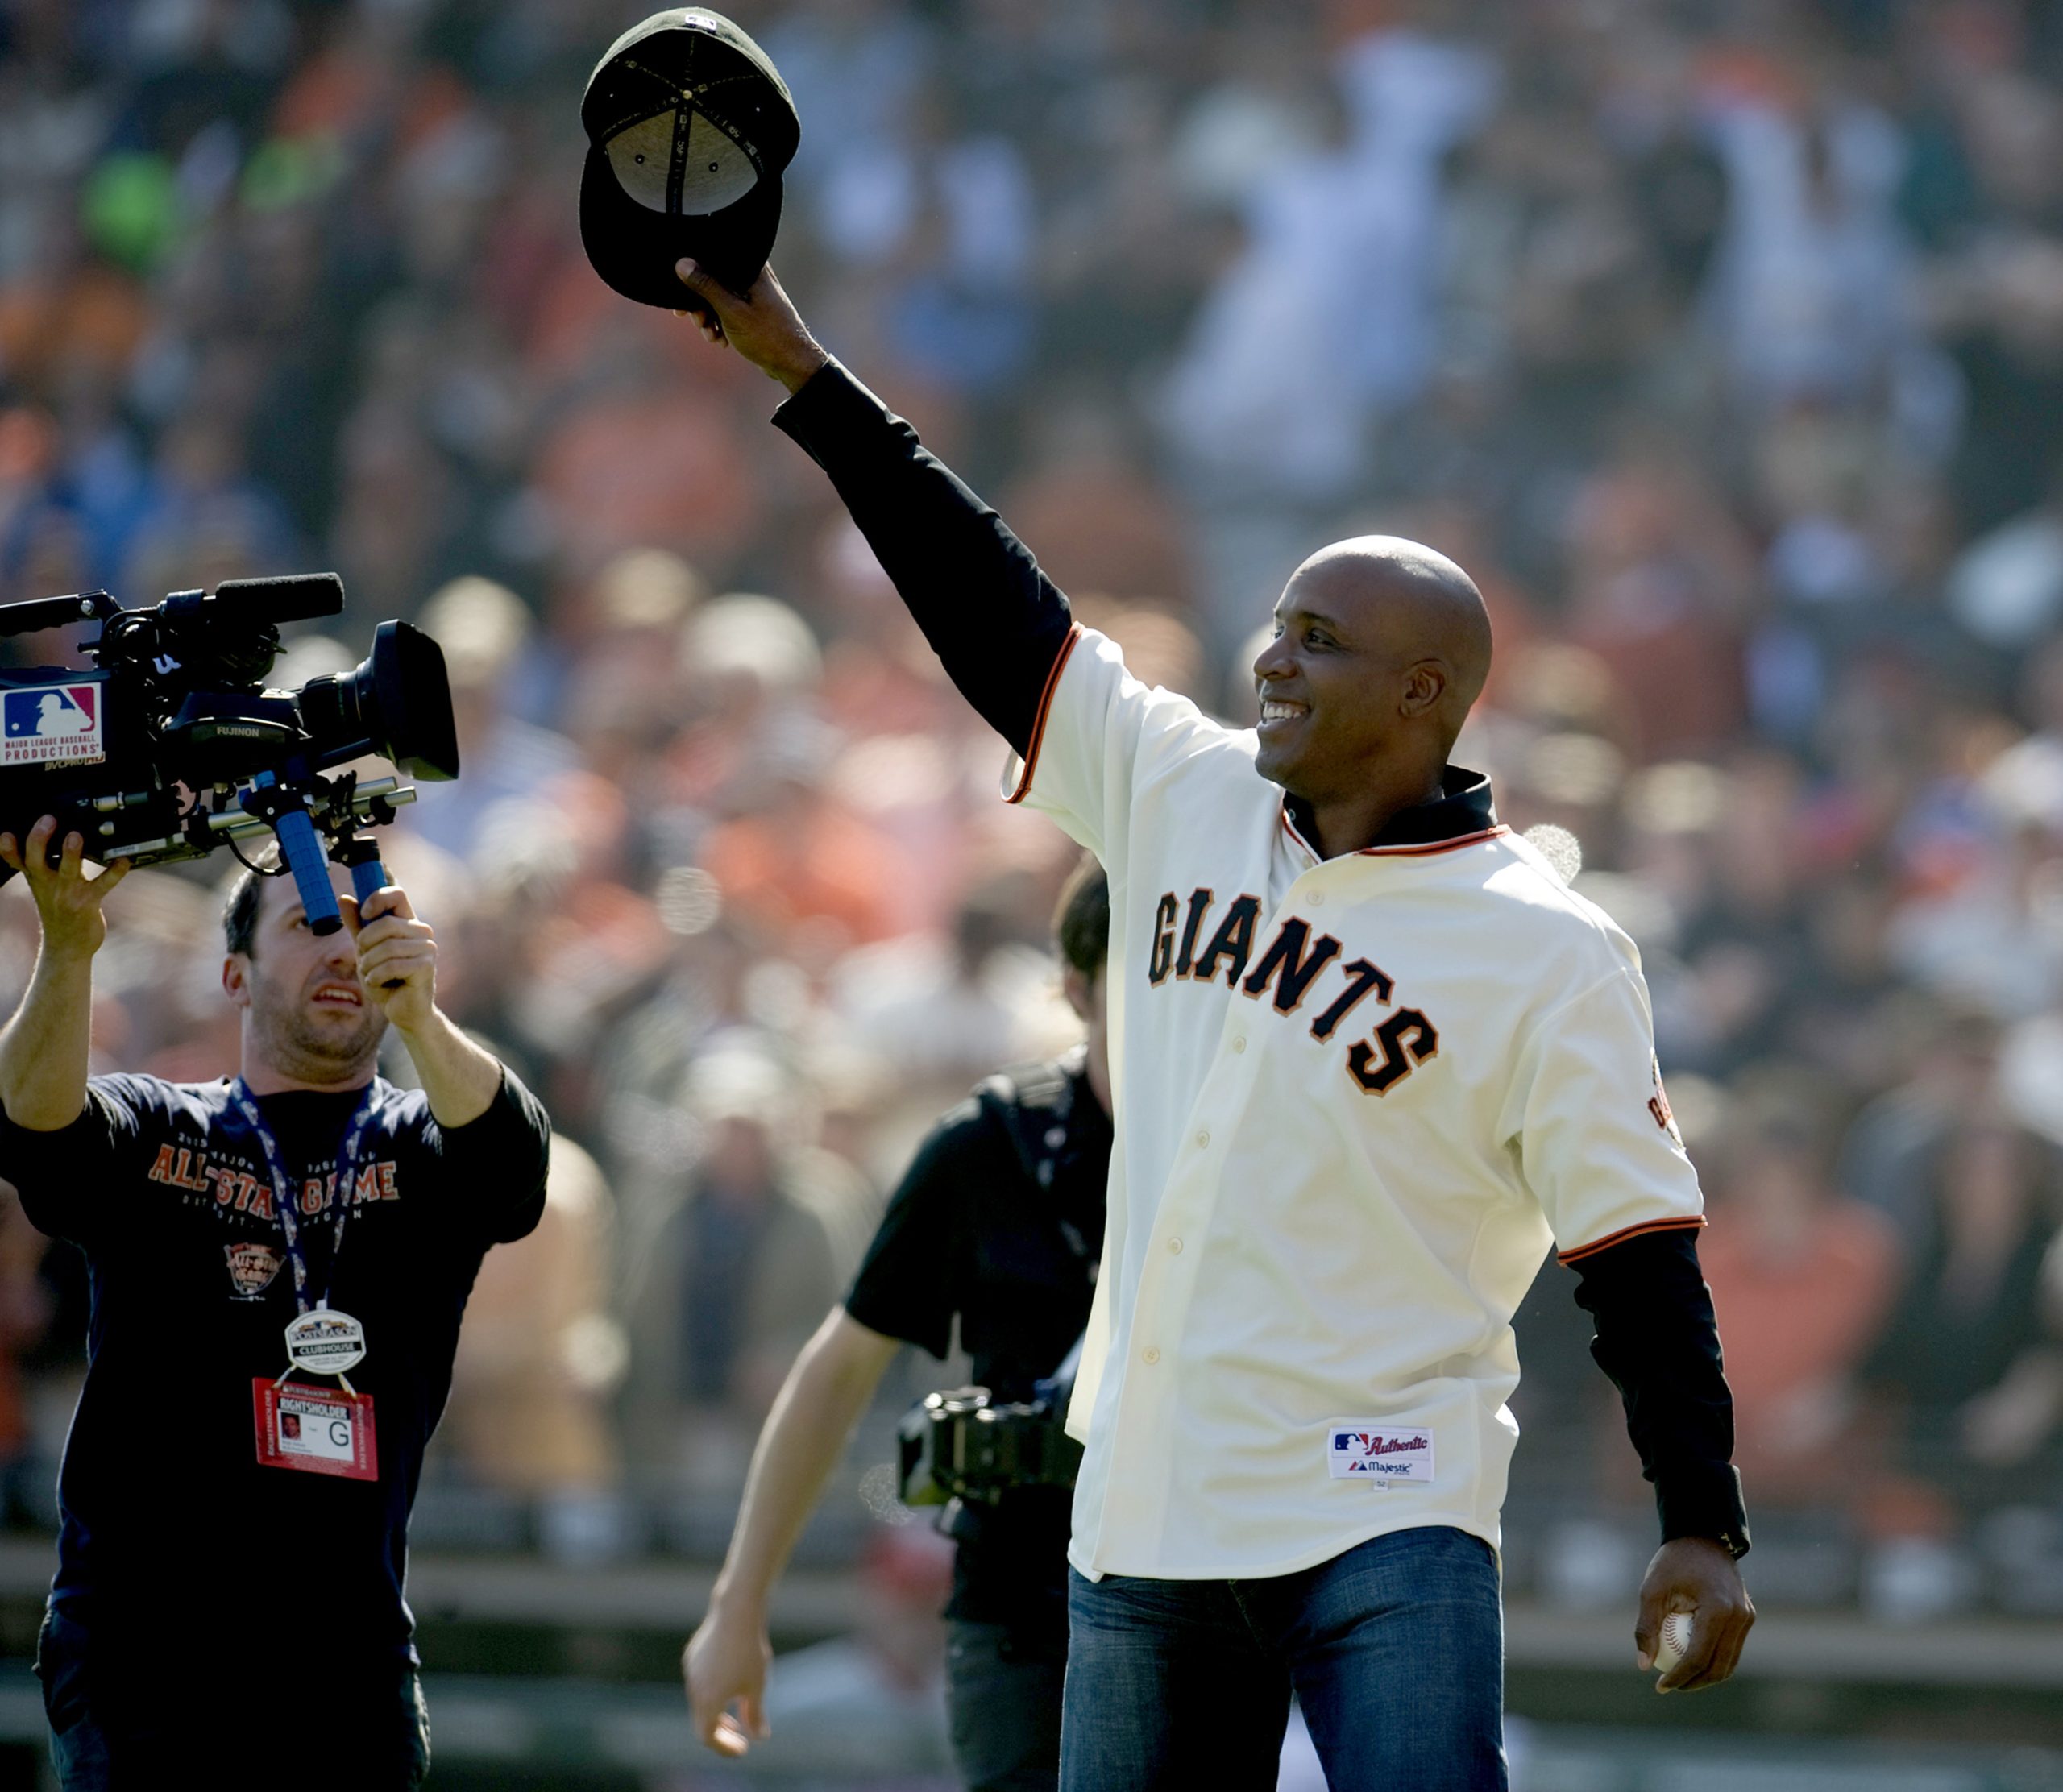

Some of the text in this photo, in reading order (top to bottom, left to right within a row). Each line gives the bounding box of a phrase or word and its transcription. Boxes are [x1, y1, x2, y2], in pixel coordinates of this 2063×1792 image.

[217, 726, 260, 737] FUJINON
[4, 734, 96, 749] MAJOR LEAGUE BASEBALL
[5, 742, 98, 761] PRODUCTIONS
[1148, 887, 1440, 1097] GIANTS
[148, 1143, 299, 1221] ALL-STA
[299, 1342, 356, 1357] CLUBHOUSE
[280, 1397, 348, 1420] RIGHTSHOLDER
[329, 1421, 350, 1447] G
[1364, 1436, 1428, 1456] Authentic
[1368, 1461, 1412, 1474] Majestic
